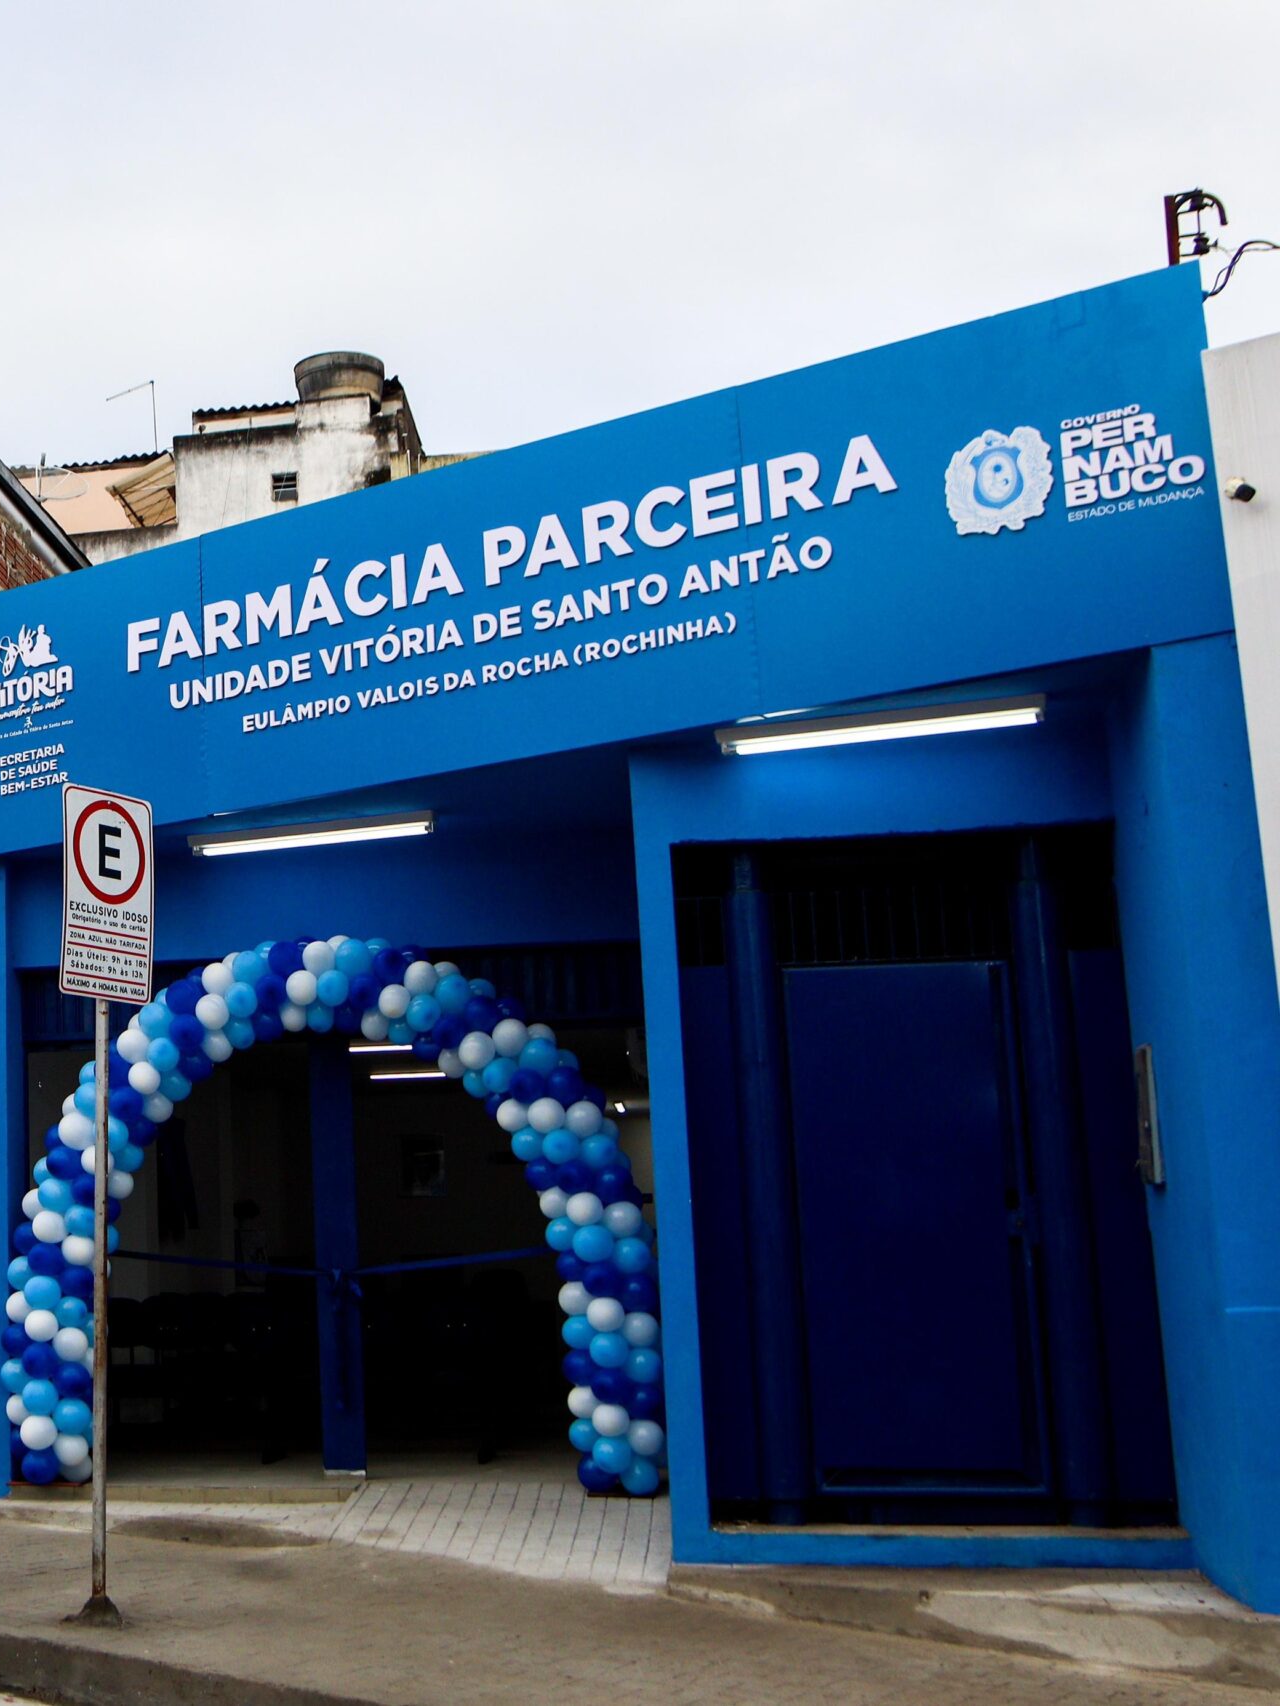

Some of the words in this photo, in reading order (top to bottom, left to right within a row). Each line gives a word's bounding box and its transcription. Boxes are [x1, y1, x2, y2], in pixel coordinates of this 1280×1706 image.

[1060, 403, 1140, 430] GOVERNO
[1060, 412, 1157, 458] PER
[1061, 434, 1174, 482] NAM
[1065, 455, 1206, 508] BUCO
[1068, 503, 1116, 522] ESTADO
[1119, 498, 1136, 512] DE
[1138, 485, 1205, 508] MUDANÇA
[126, 543, 465, 673] FARMÁCIA
[482, 434, 899, 587] PARCEIRA
[169, 652, 312, 710] UNIDADE
[319, 619, 464, 675] VITÓRIA
[473, 605, 522, 644] DE
[533, 573, 669, 631] SANTO
[679, 532, 833, 599] ANTÃO
[242, 695, 351, 733] EULÂMPIO
[357, 675, 439, 709] VALOIS
[444, 669, 476, 692] DA
[482, 649, 569, 684] ROCHA
[573, 611, 737, 666] (ROCHINHA)
[0, 768, 16, 782] DE
[18, 759, 59, 779] SAÚDE
[0, 771, 69, 796] BEM-ESTAR
[98, 824, 122, 880] E
[69, 900, 118, 919] EXCLUSIVO
[123, 910, 148, 924] IDOSO
[71, 912, 102, 924] Obrigatório
[129, 924, 146, 932] cartão
[69, 931, 85, 940] ZONA
[88, 935, 103, 943] AZUL
[105, 937, 117, 945] NÃO
[120, 940, 146, 950] TARIFADA
[66, 947, 83, 957] Dias
[87, 949, 109, 962] Úteis:
[111, 955, 120, 964] 9h
[124, 957, 132, 966] às
[136, 960, 147, 968] 18h
[70, 959, 104, 973] Sábados:
[108, 966, 117, 975] 9h
[120, 968, 128, 976] às
[132, 970, 143, 979] 13h
[66, 976, 90, 988] MÁXIMO
[120, 986, 128, 994] NA
[130, 988, 145, 997] VAGA
